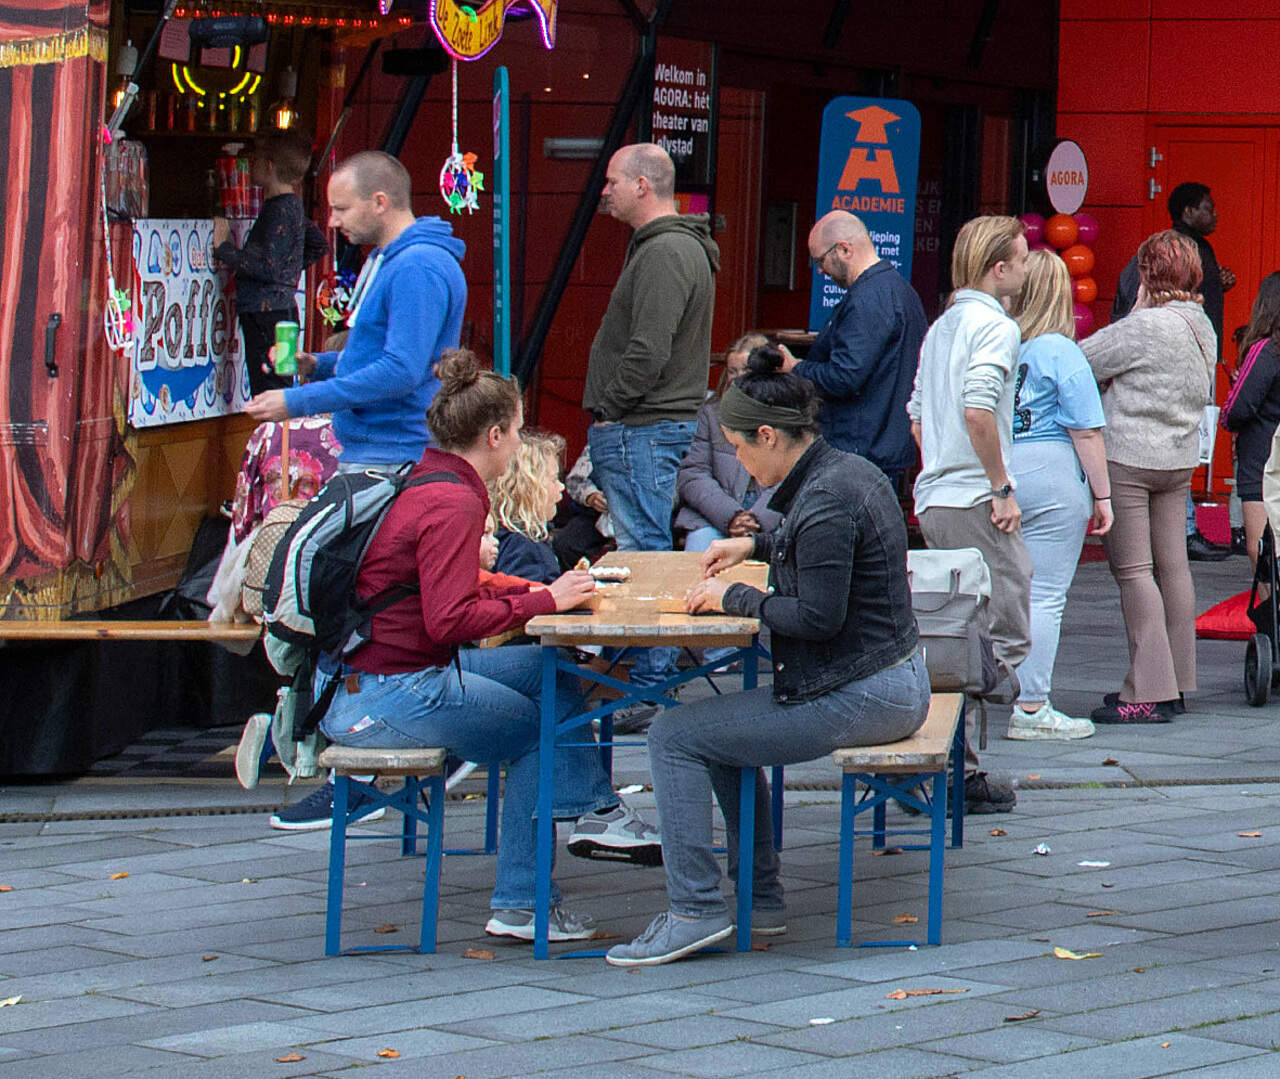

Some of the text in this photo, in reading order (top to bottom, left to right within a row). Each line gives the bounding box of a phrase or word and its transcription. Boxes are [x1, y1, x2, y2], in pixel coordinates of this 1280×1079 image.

[654, 63, 707, 86] Welkom in
[653, 87, 710, 110] AGORA: hét
[652, 111, 709, 133] theater van
[1050, 170, 1085, 186] AGORA
[831, 195, 905, 214] ACADEMIE
